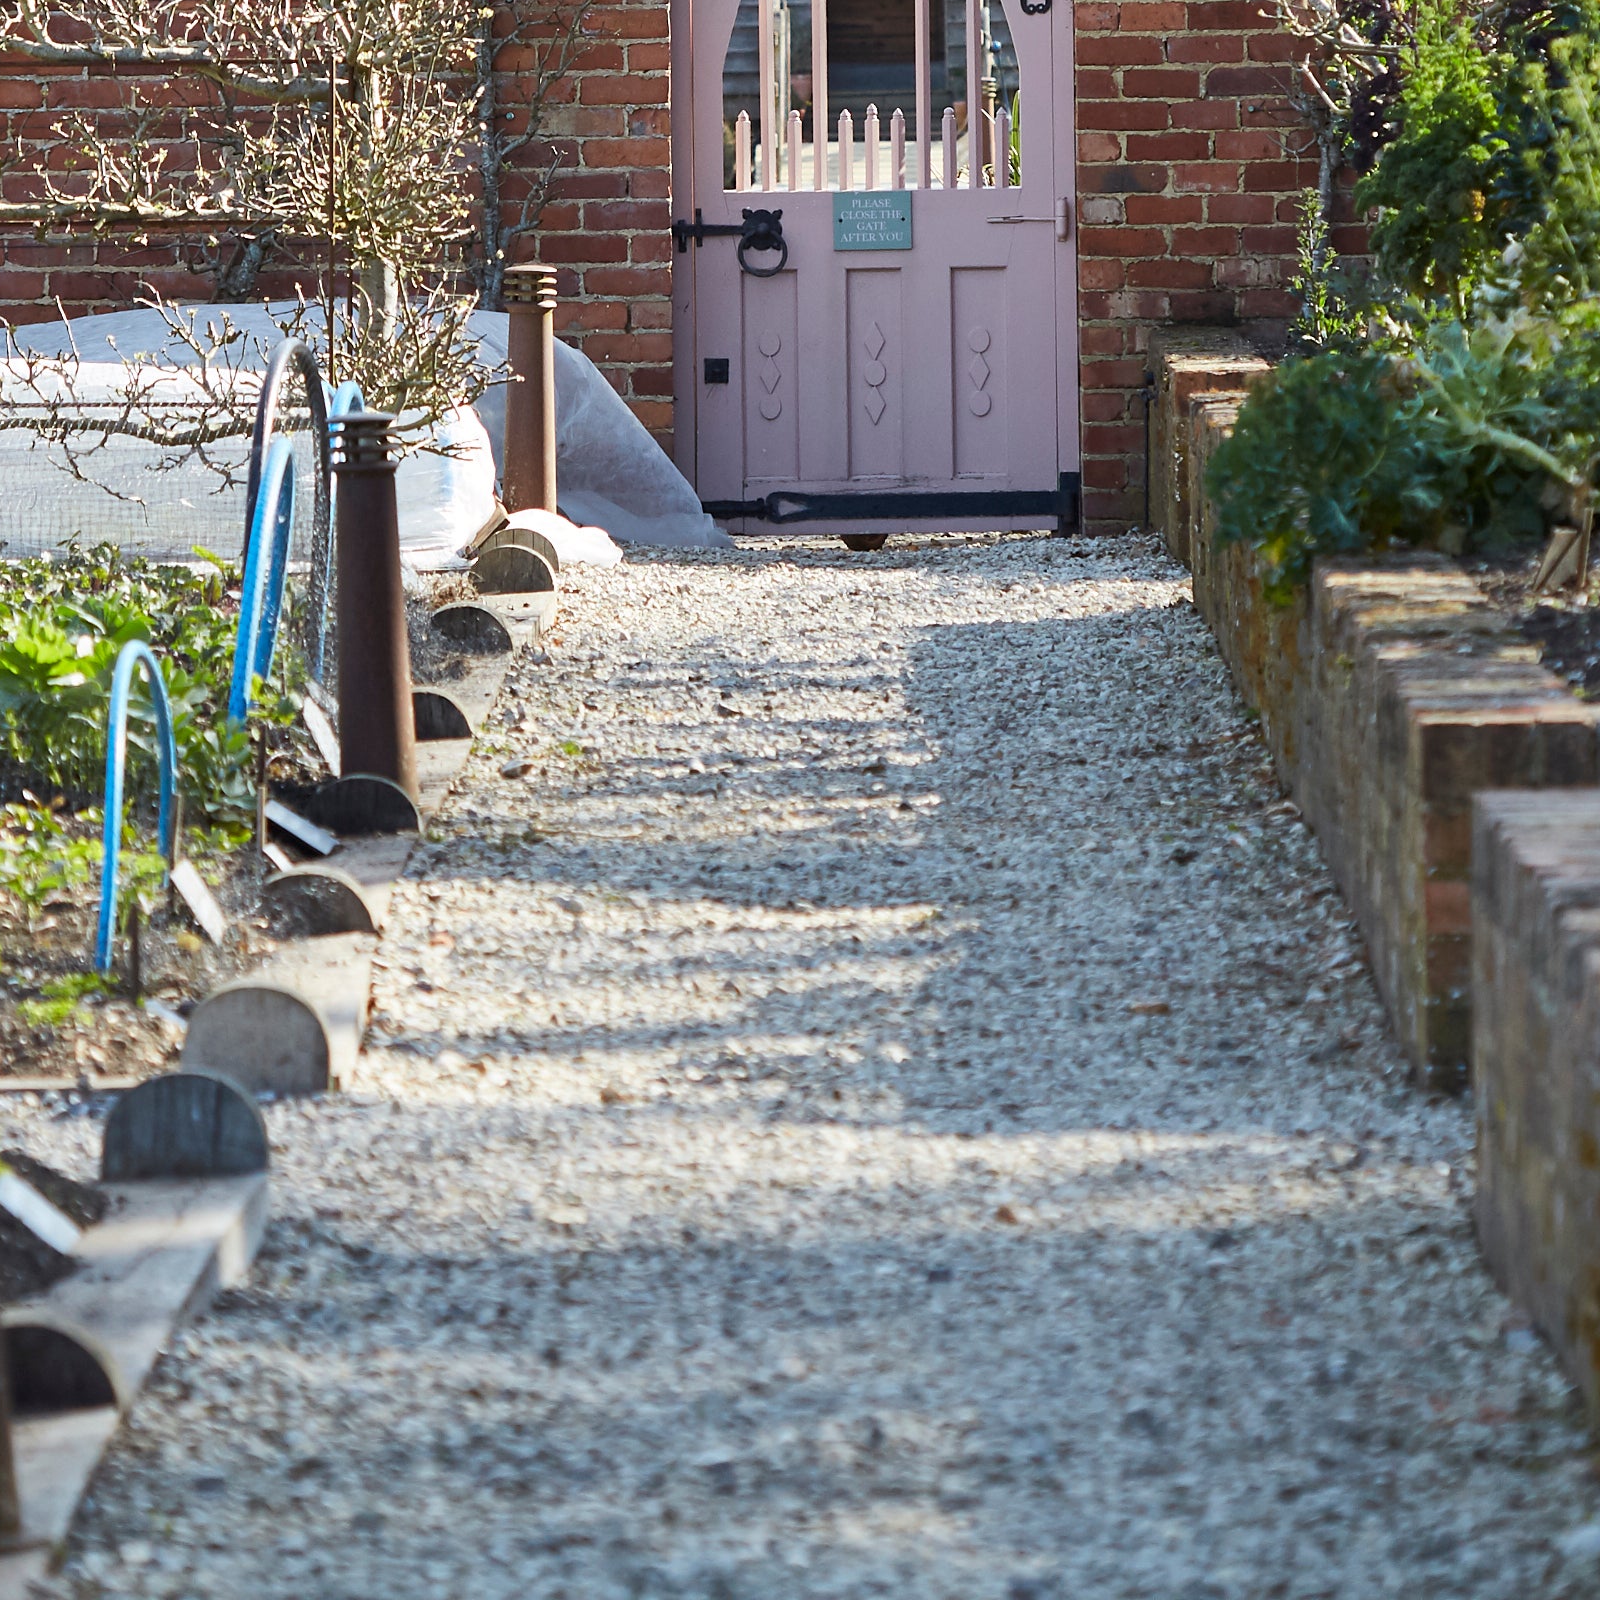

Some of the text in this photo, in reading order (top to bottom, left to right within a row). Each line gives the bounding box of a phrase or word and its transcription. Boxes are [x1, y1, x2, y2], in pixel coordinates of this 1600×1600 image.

[852, 199, 891, 208] PLEASE
[840, 210, 902, 219] CLOSE THE
[856, 221, 887, 230] GATE
[840, 232, 903, 242] AFTER YOU
